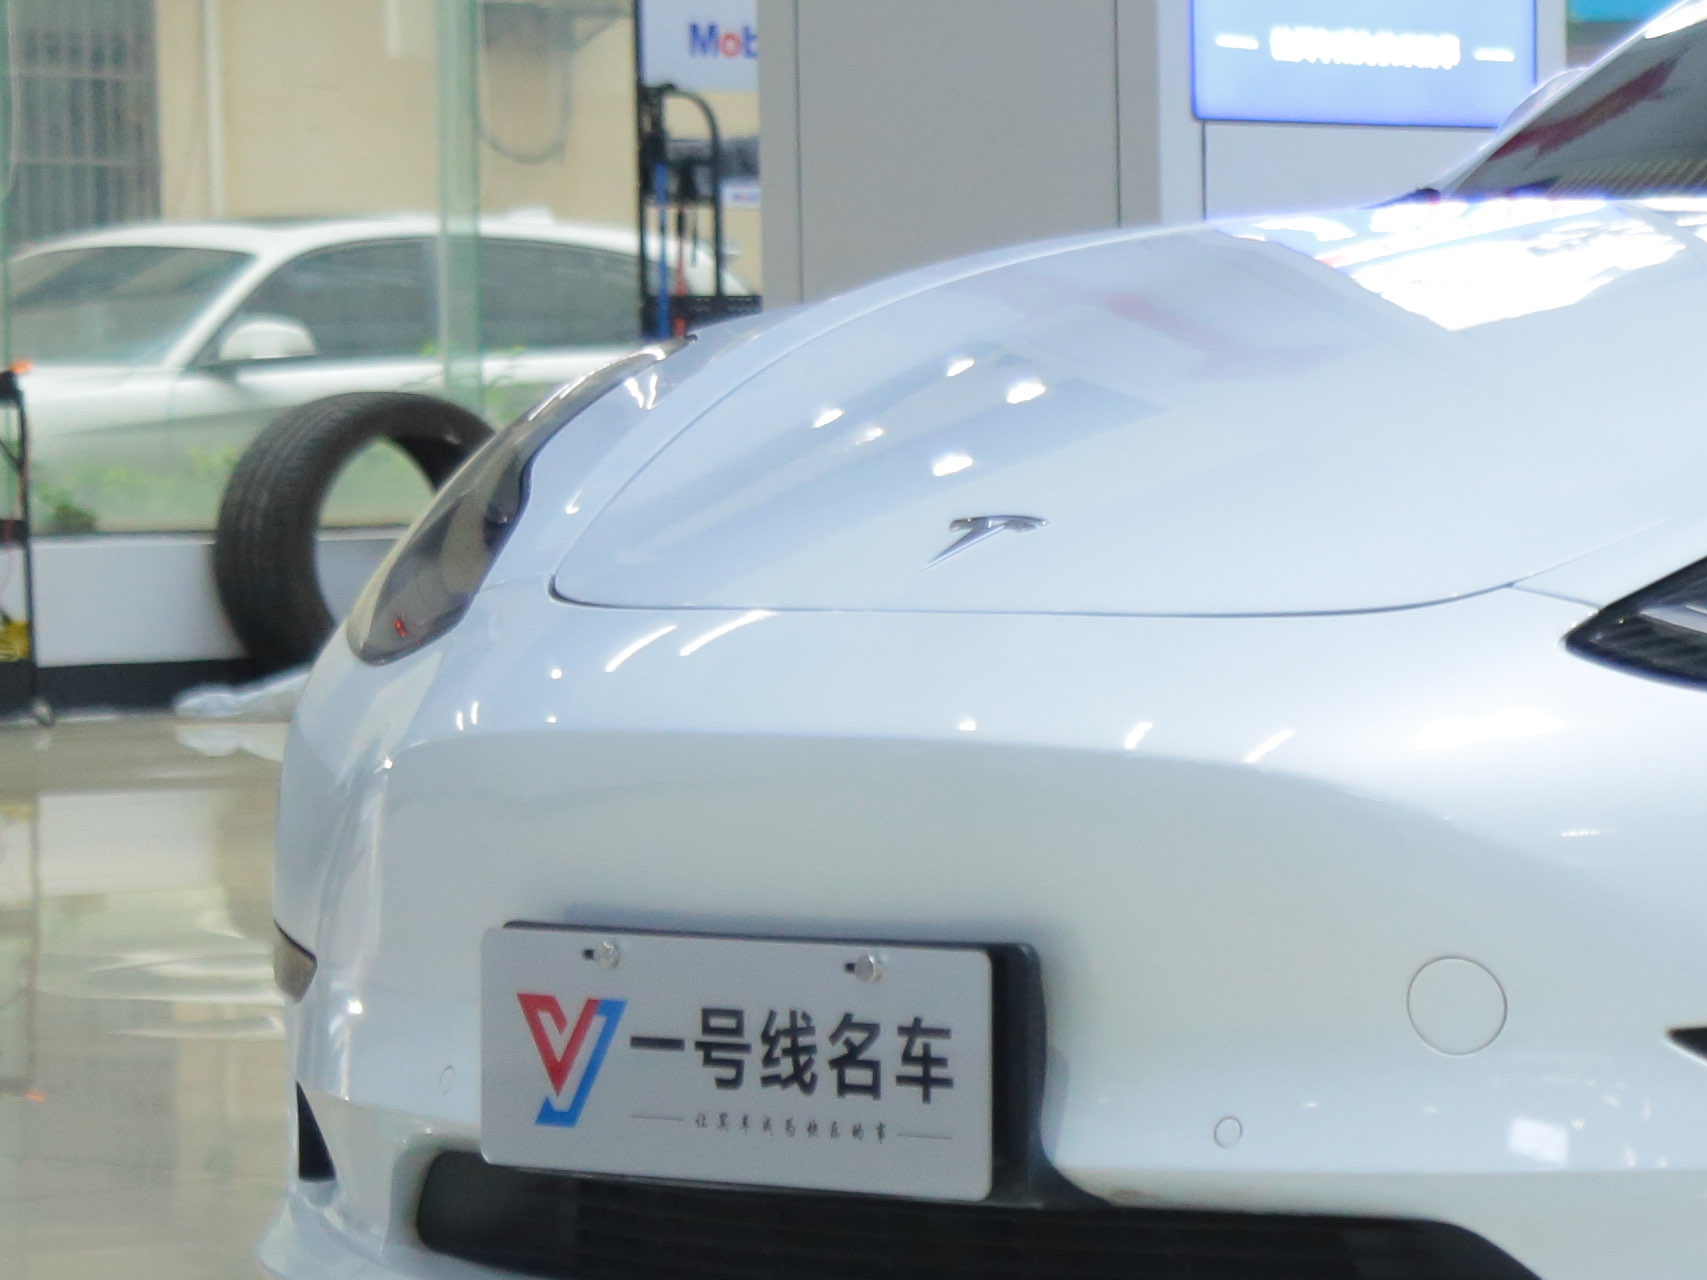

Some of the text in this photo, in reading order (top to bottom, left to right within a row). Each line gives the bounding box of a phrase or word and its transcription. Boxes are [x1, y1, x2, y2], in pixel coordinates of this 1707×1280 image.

[630, 1007, 954, 1105] 一号线名车
